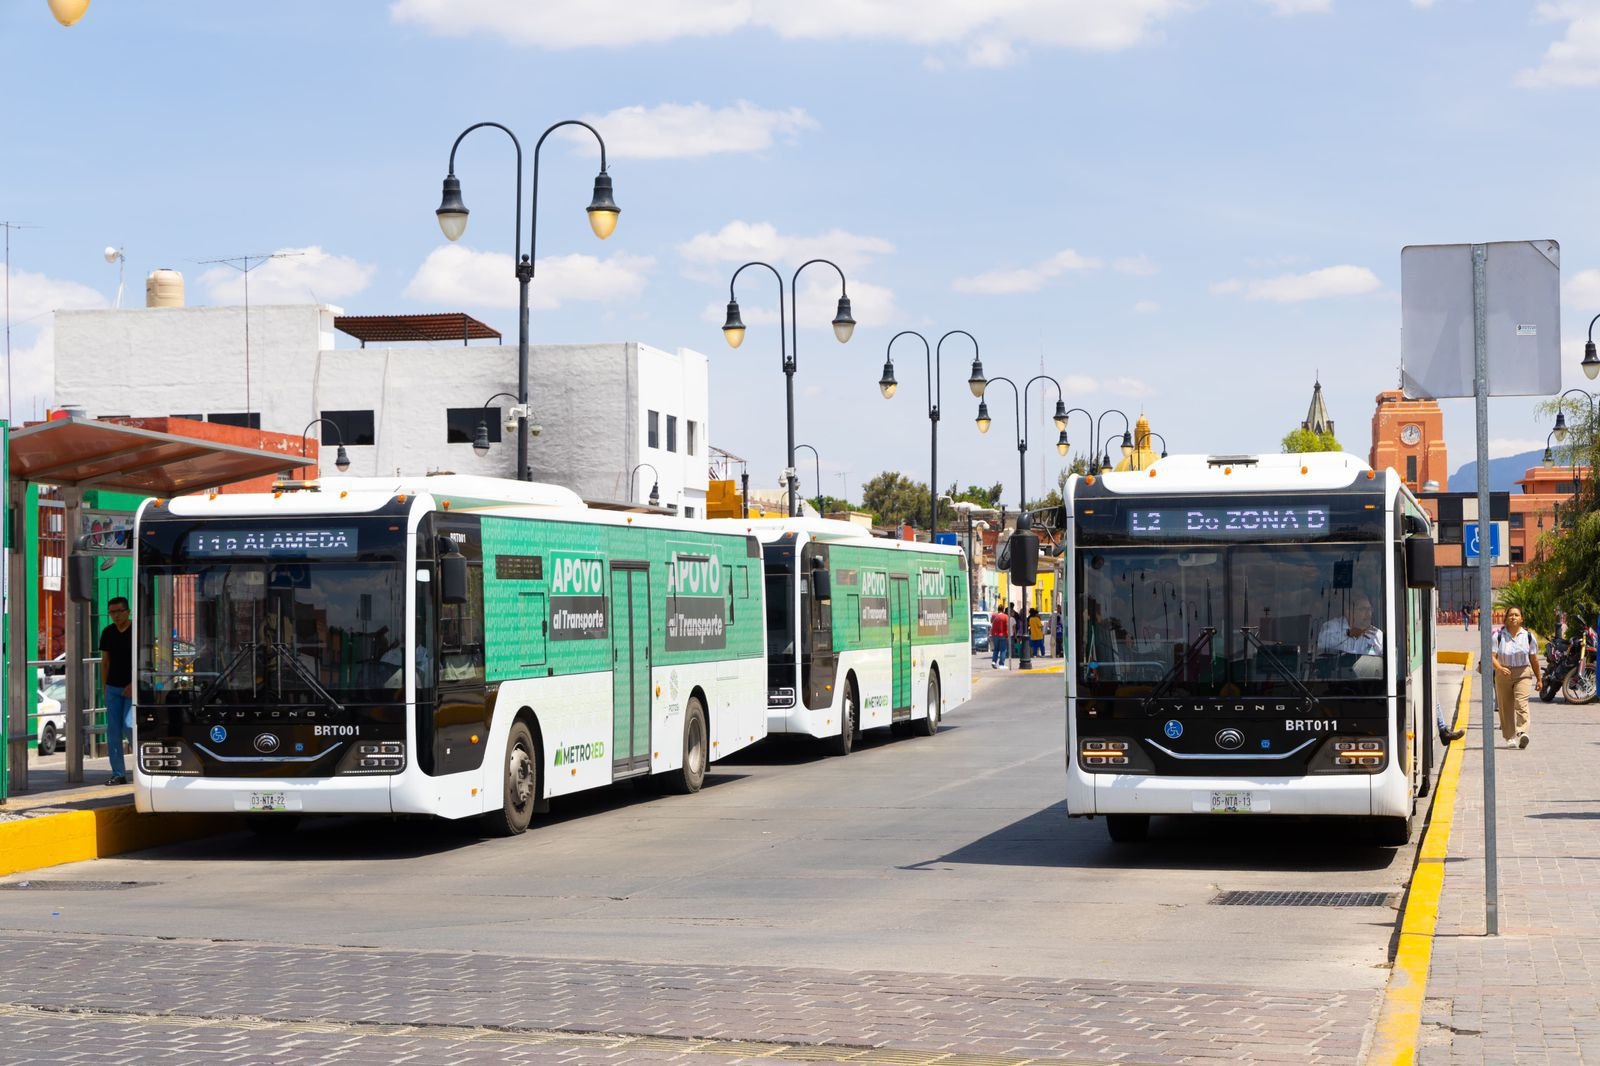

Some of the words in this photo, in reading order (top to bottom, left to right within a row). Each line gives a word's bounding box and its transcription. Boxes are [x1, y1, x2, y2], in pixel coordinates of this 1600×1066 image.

[1225, 510, 1299, 529] ZONA
[243, 531, 349, 549] ALAMEDA
[552, 557, 601, 594] APOYO
[667, 551, 720, 594] APOYO
[861, 571, 886, 596] APOYO
[917, 566, 945, 596] APOYO
[553, 610, 562, 630] al
[562, 610, 604, 633] Transporte
[678, 614, 723, 644] Transporte
[314, 725, 360, 736] BRT001
[1285, 720, 1338, 731] BRT011
[1212, 796, 1251, 806] 05-NTA-13
